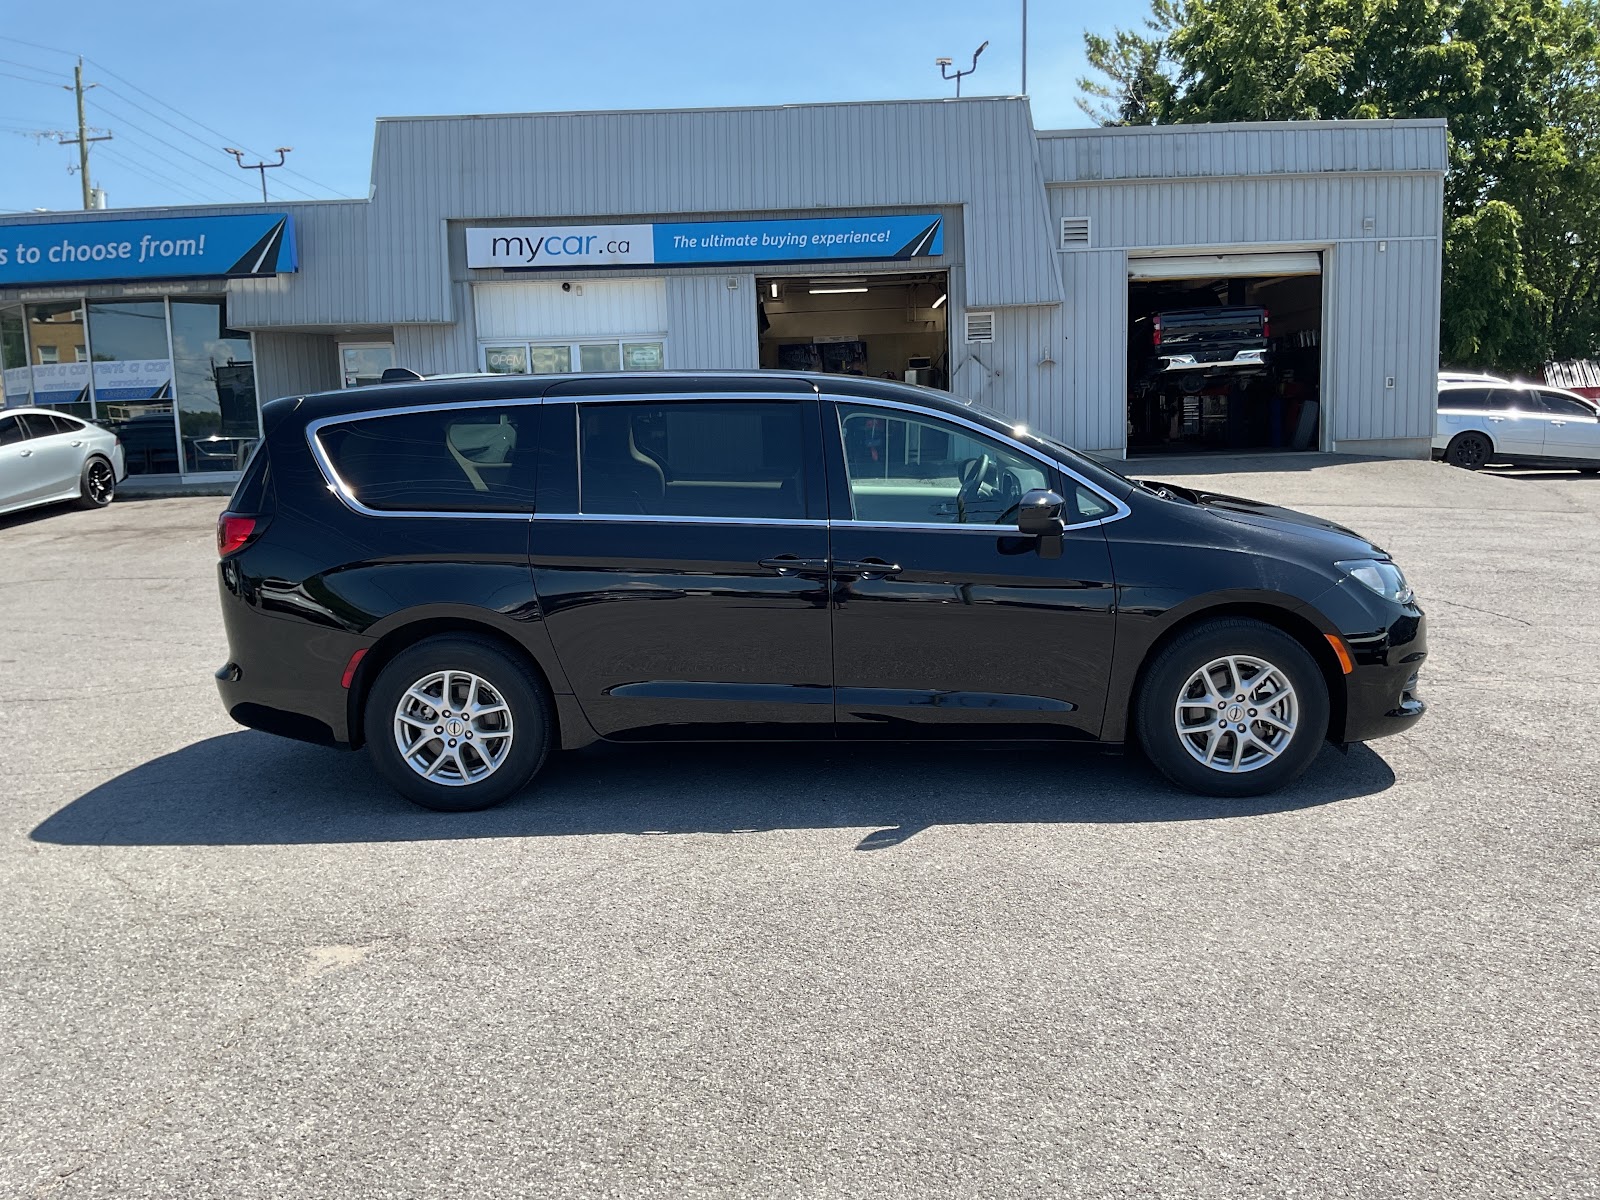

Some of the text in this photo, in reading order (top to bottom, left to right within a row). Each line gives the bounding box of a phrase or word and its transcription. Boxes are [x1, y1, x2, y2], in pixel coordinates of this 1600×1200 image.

[16, 243, 41, 264] to
[48, 240, 132, 263] choose
[138, 234, 206, 263] from!
[492, 235, 630, 263] mycar.ca
[673, 230, 891, 249] The ultimate buying experience!
[94, 361, 170, 374] rent a car
[490, 354, 522, 366] OPEN
